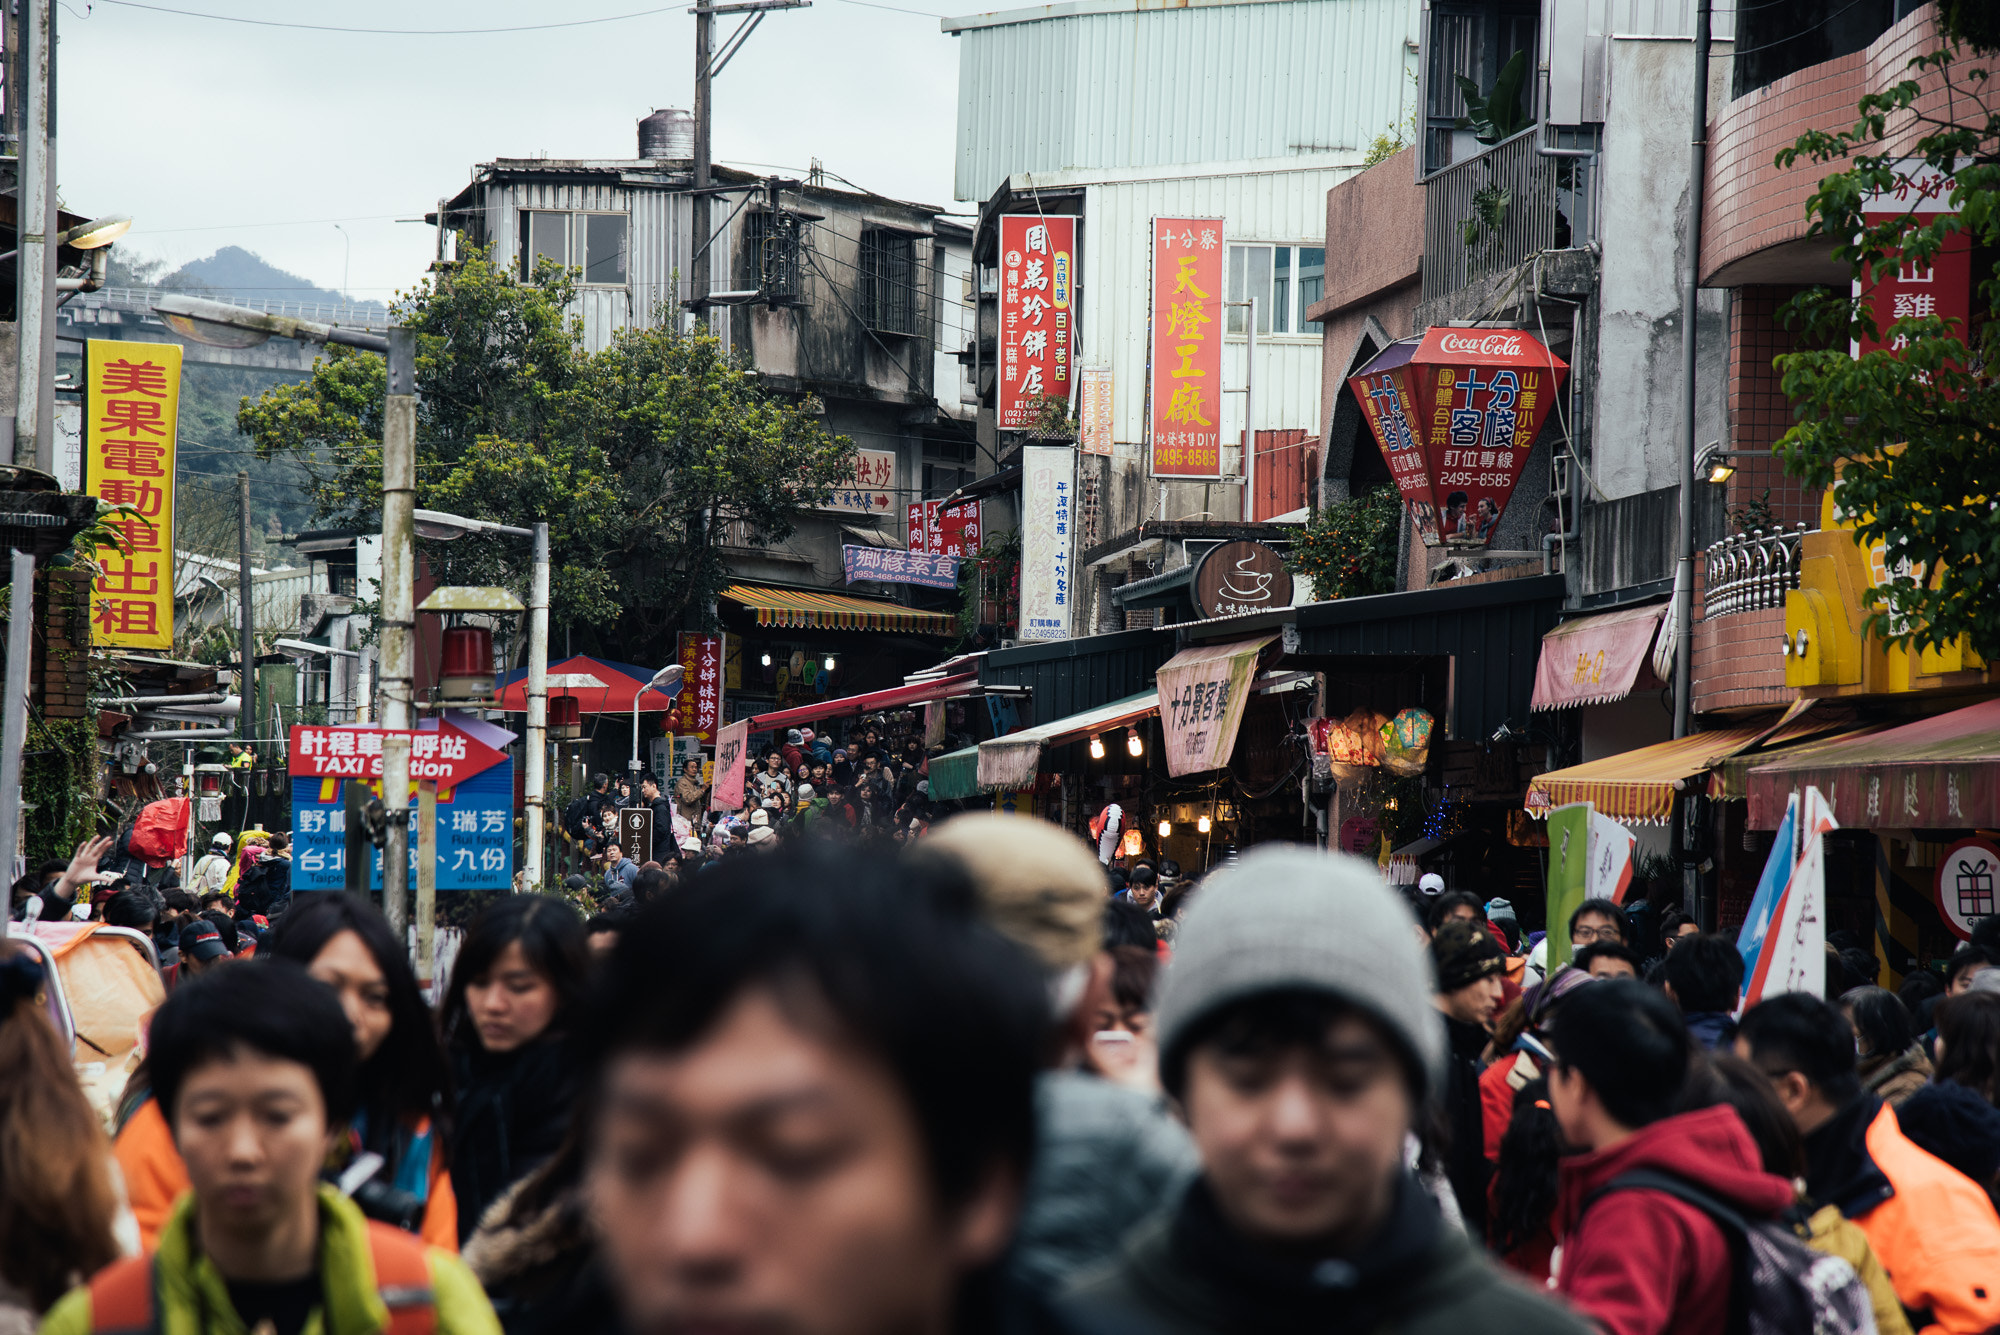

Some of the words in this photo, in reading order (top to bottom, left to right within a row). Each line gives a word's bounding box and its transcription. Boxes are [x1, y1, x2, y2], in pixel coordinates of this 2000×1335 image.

[1160, 228, 1218, 250] 十分寮
[1006, 269, 1019, 304] 傳統
[1019, 225, 1051, 394] 周萬珍餅店
[1005, 311, 1019, 382] 手工糕餅
[1054, 312, 1067, 381] 百年老店
[1163, 255, 1212, 427] 天燈工廠
[1441, 333, 1524, 358] Coca-Cola
[1430, 368, 1456, 445] 團體合菜
[1455, 368, 1520, 410] 十分
[1514, 371, 1539, 448] 山產小吃
[1450, 408, 1517, 449] 客棧
[1155, 449, 1217, 467] 2495-8585
[1443, 450, 1514, 469] 訂位專線
[92, 358, 168, 635] 美果電動車出租
[1439, 471, 1511, 487] 2495-8585
[853, 570, 911, 582] 0953-468-065
[312, 756, 365, 774] TAXI
[370, 758, 454, 777] Stion
[307, 835, 331, 845] Yeh
[452, 835, 474, 846] Rui
[477, 834, 505, 848] fang
[309, 872, 345, 884] Taipe
[457, 873, 498, 884] Jiufen
